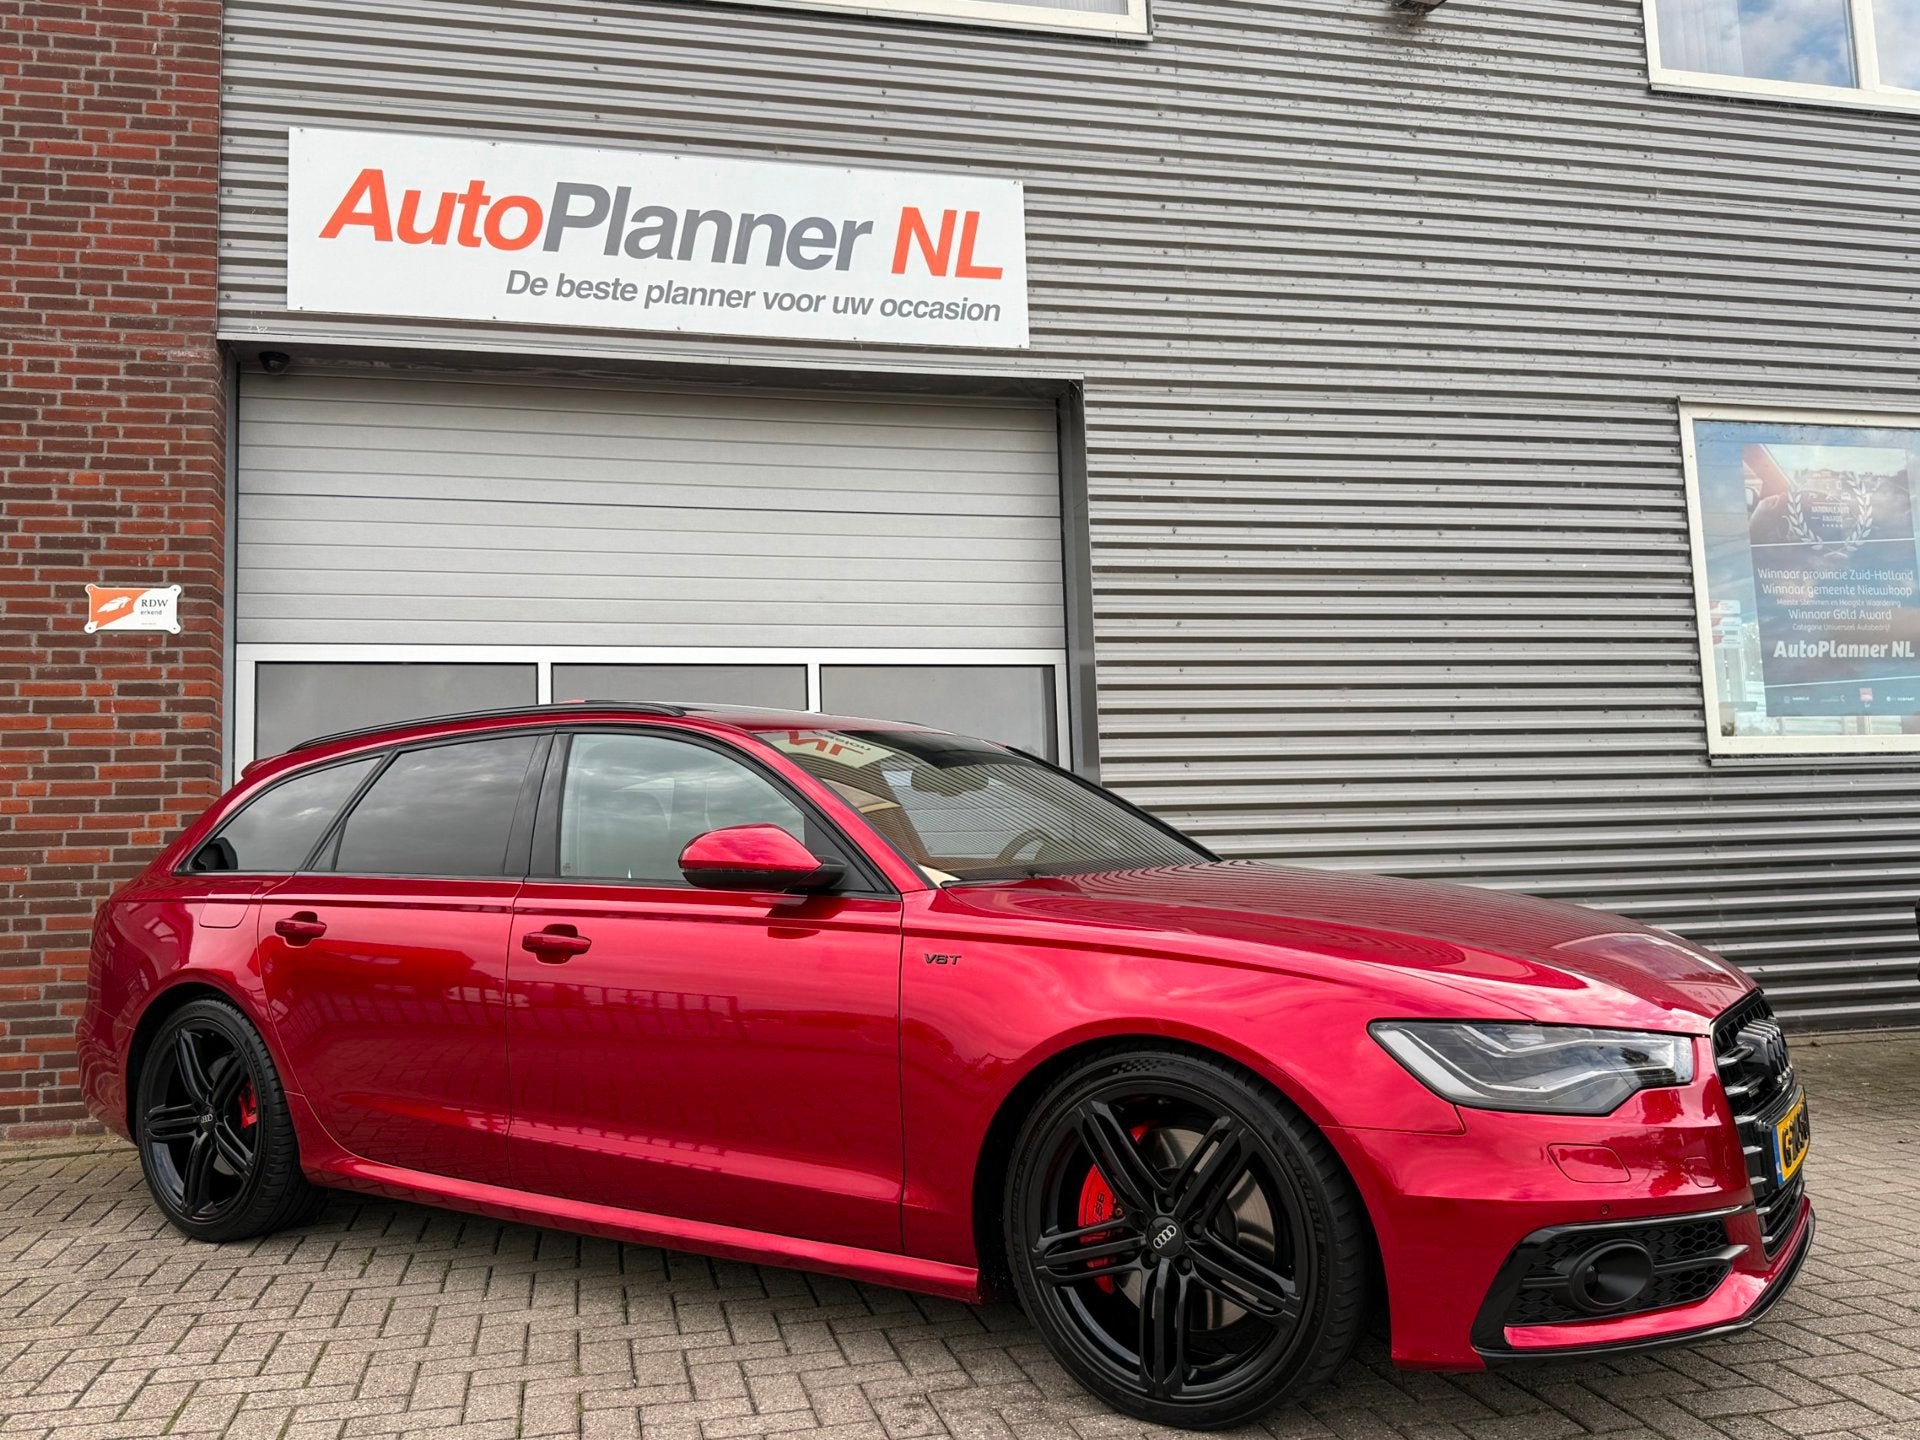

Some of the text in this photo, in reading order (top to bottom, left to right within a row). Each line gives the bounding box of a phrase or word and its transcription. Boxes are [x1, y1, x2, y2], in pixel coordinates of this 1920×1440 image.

[318, 168, 1004, 280] AutoPlanner NL
[506, 269, 1001, 322] De beste planner voor uw occasion
[1758, 567, 1914, 582] Winnaar provincie Zuid-Holland
[1762, 583, 1913, 598] Winnaar gemeente Nieuwkoop
[141, 599, 169, 608] RDW
[1788, 608, 1892, 620] Winnaar Gold Award
[1773, 640, 1915, 658] AutoPlanner NL
